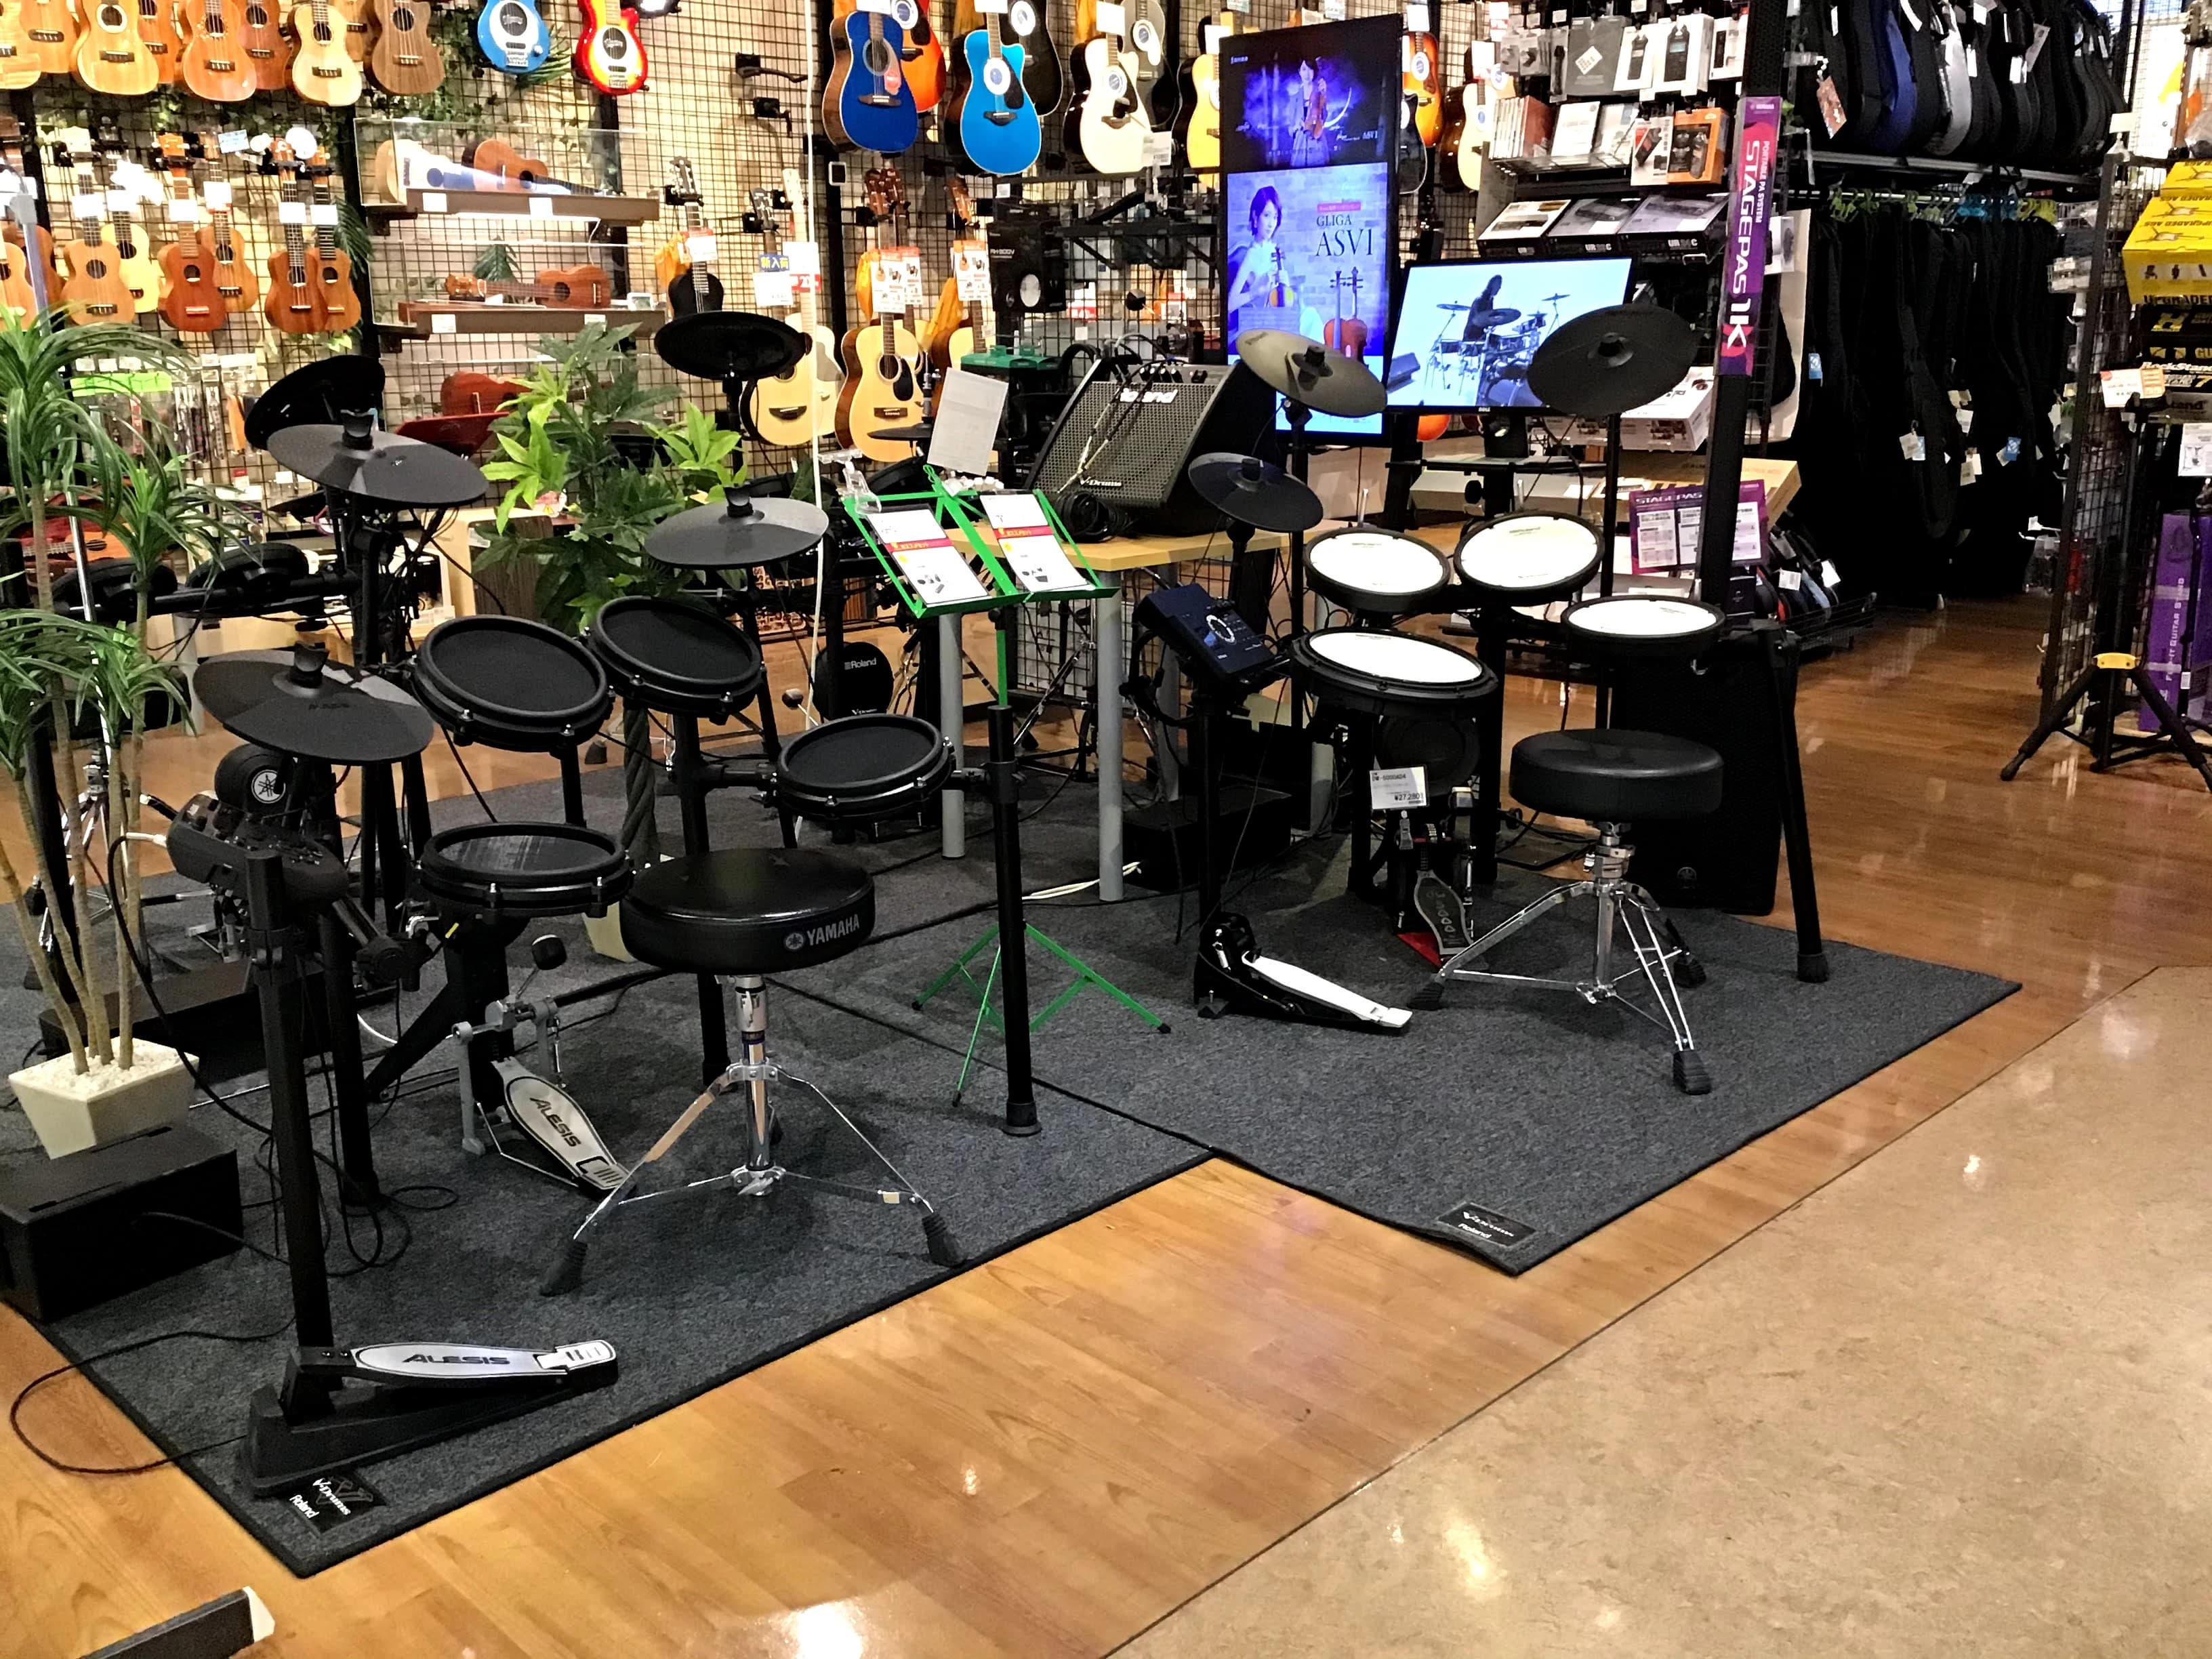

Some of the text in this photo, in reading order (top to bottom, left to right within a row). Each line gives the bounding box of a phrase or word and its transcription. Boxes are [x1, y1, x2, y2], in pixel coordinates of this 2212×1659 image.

[1755, 140, 1770, 223] PORTABLE PA SYSTEM
[1316, 214, 1352, 227] GLIGA
[1727, 140, 1760, 350] STAGEPAS 1K
[1078, 476, 1122, 487] V-Drums
[851, 657, 877, 670] Roland
[806, 914, 860, 945] YAMAHA
[530, 1096, 581, 1147] ALESIS
[401, 1353, 512, 1366] ALESIS
[289, 1494, 320, 1519] Roland
[312, 1477, 351, 1516] V-Drums
